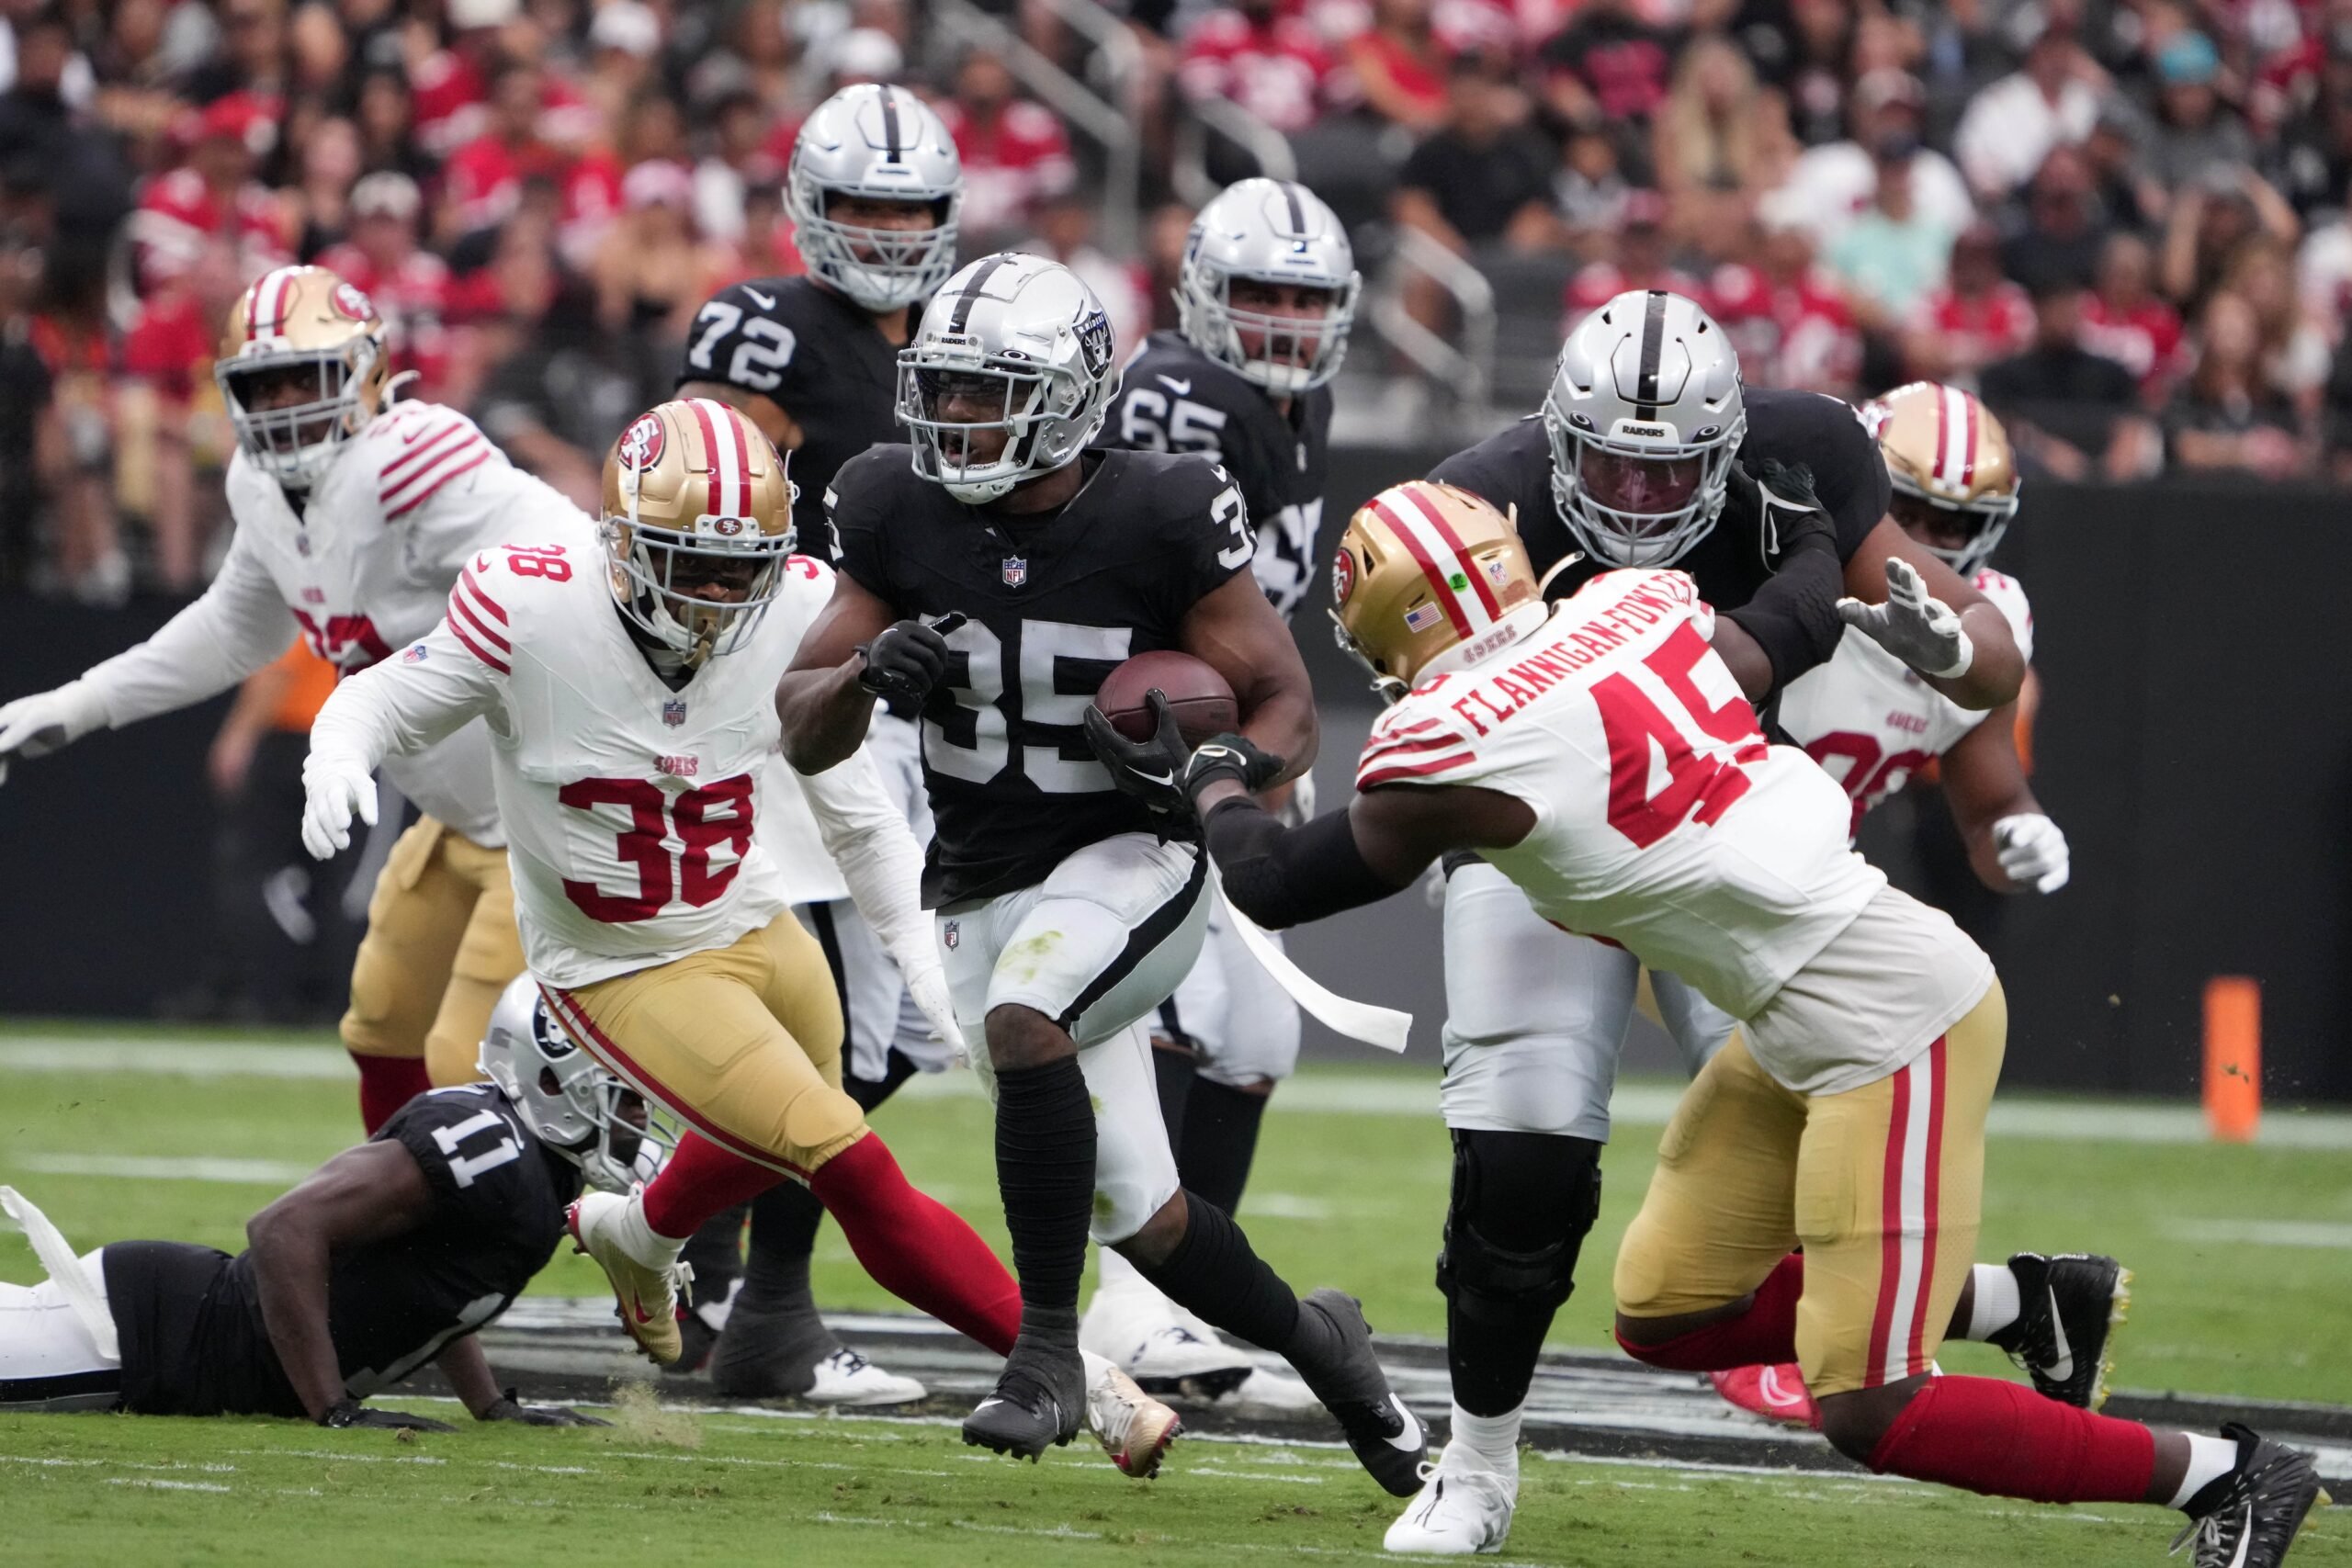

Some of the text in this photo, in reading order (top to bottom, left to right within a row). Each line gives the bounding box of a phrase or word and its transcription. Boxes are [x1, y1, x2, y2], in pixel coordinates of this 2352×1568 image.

[689, 301, 797, 391] 72
[941, 337, 967, 345] RAIDERS
[1121, 388, 1227, 465] 65
[1622, 425, 1665, 437] RAIDERS
[501, 544, 573, 583] 38
[1005, 570, 1024, 583] NFL
[1464, 624, 1518, 664] 49ERS
[919, 612, 1134, 794] 35
[1588, 616, 1769, 851] 45
[652, 755, 699, 777] 49ERS
[559, 773, 754, 923] 38
[430, 1109, 521, 1190] 11
